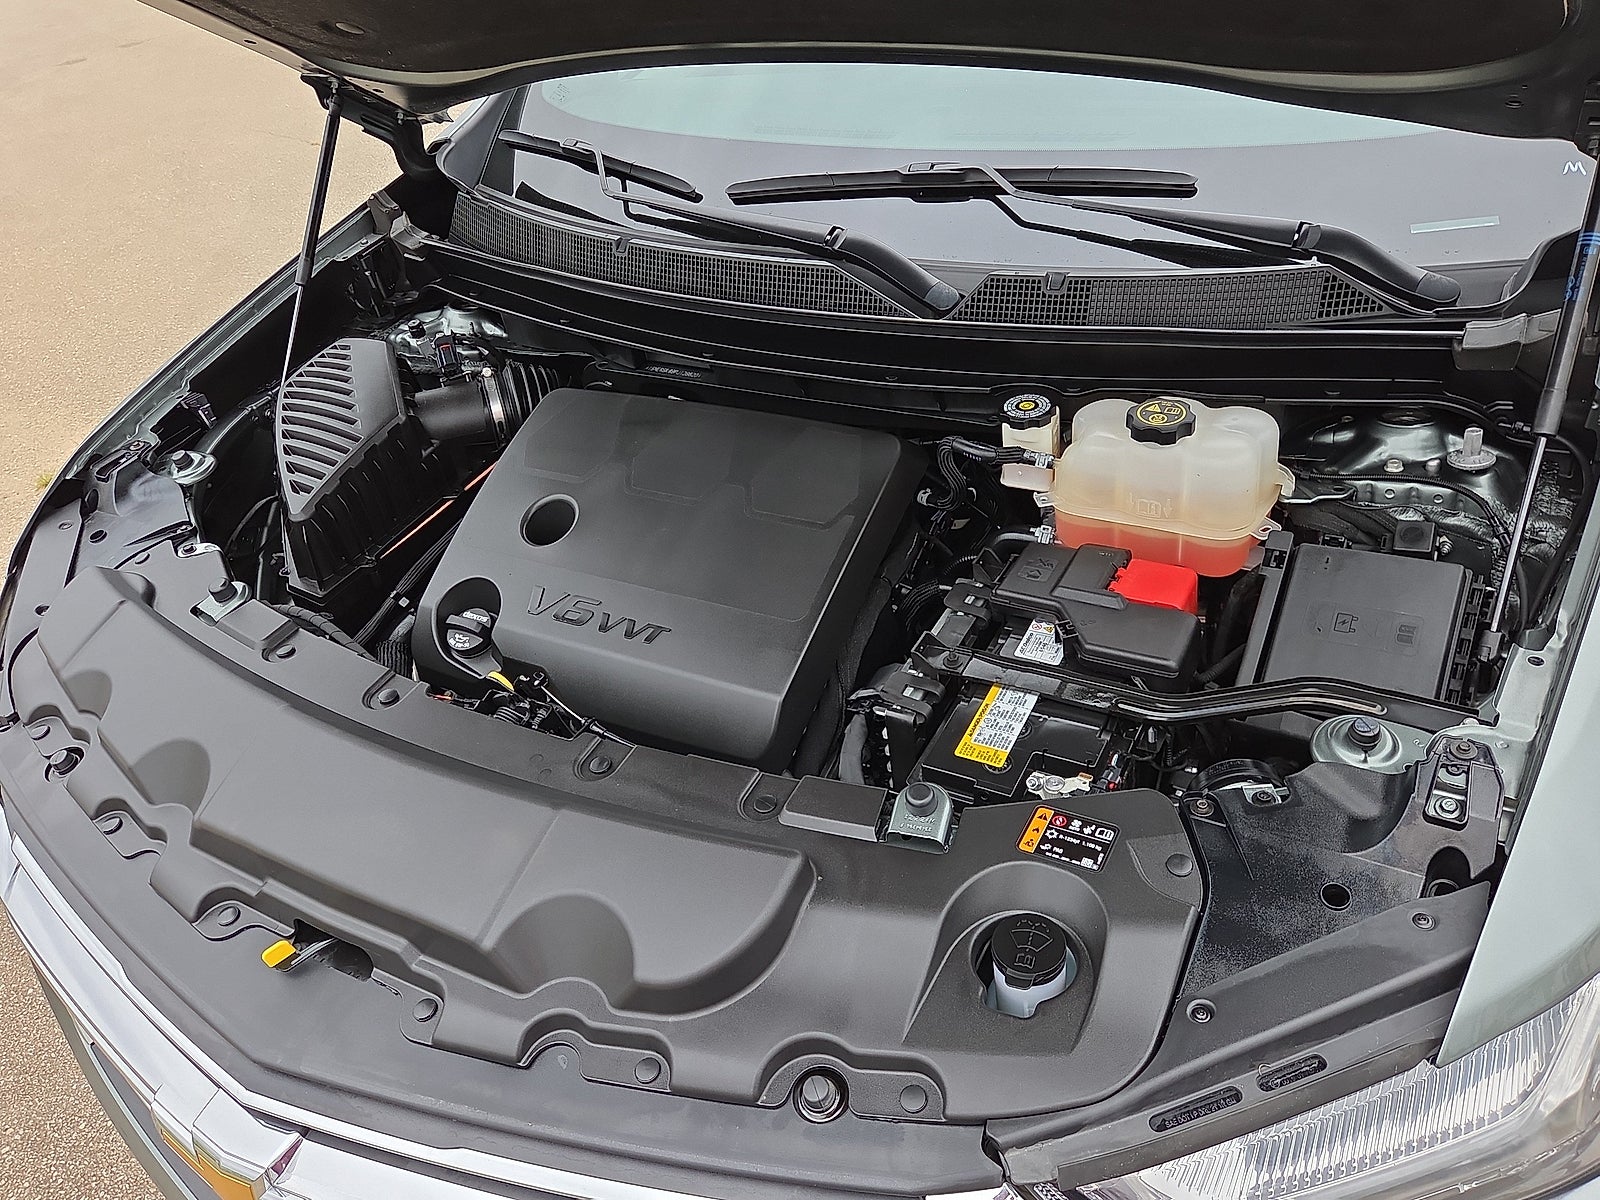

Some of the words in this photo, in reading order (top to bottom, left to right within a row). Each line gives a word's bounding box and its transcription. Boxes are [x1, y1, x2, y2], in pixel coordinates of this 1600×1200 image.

[462, 611, 489, 623] dexos
[527, 584, 603, 627] V6
[598, 611, 672, 645] VVT
